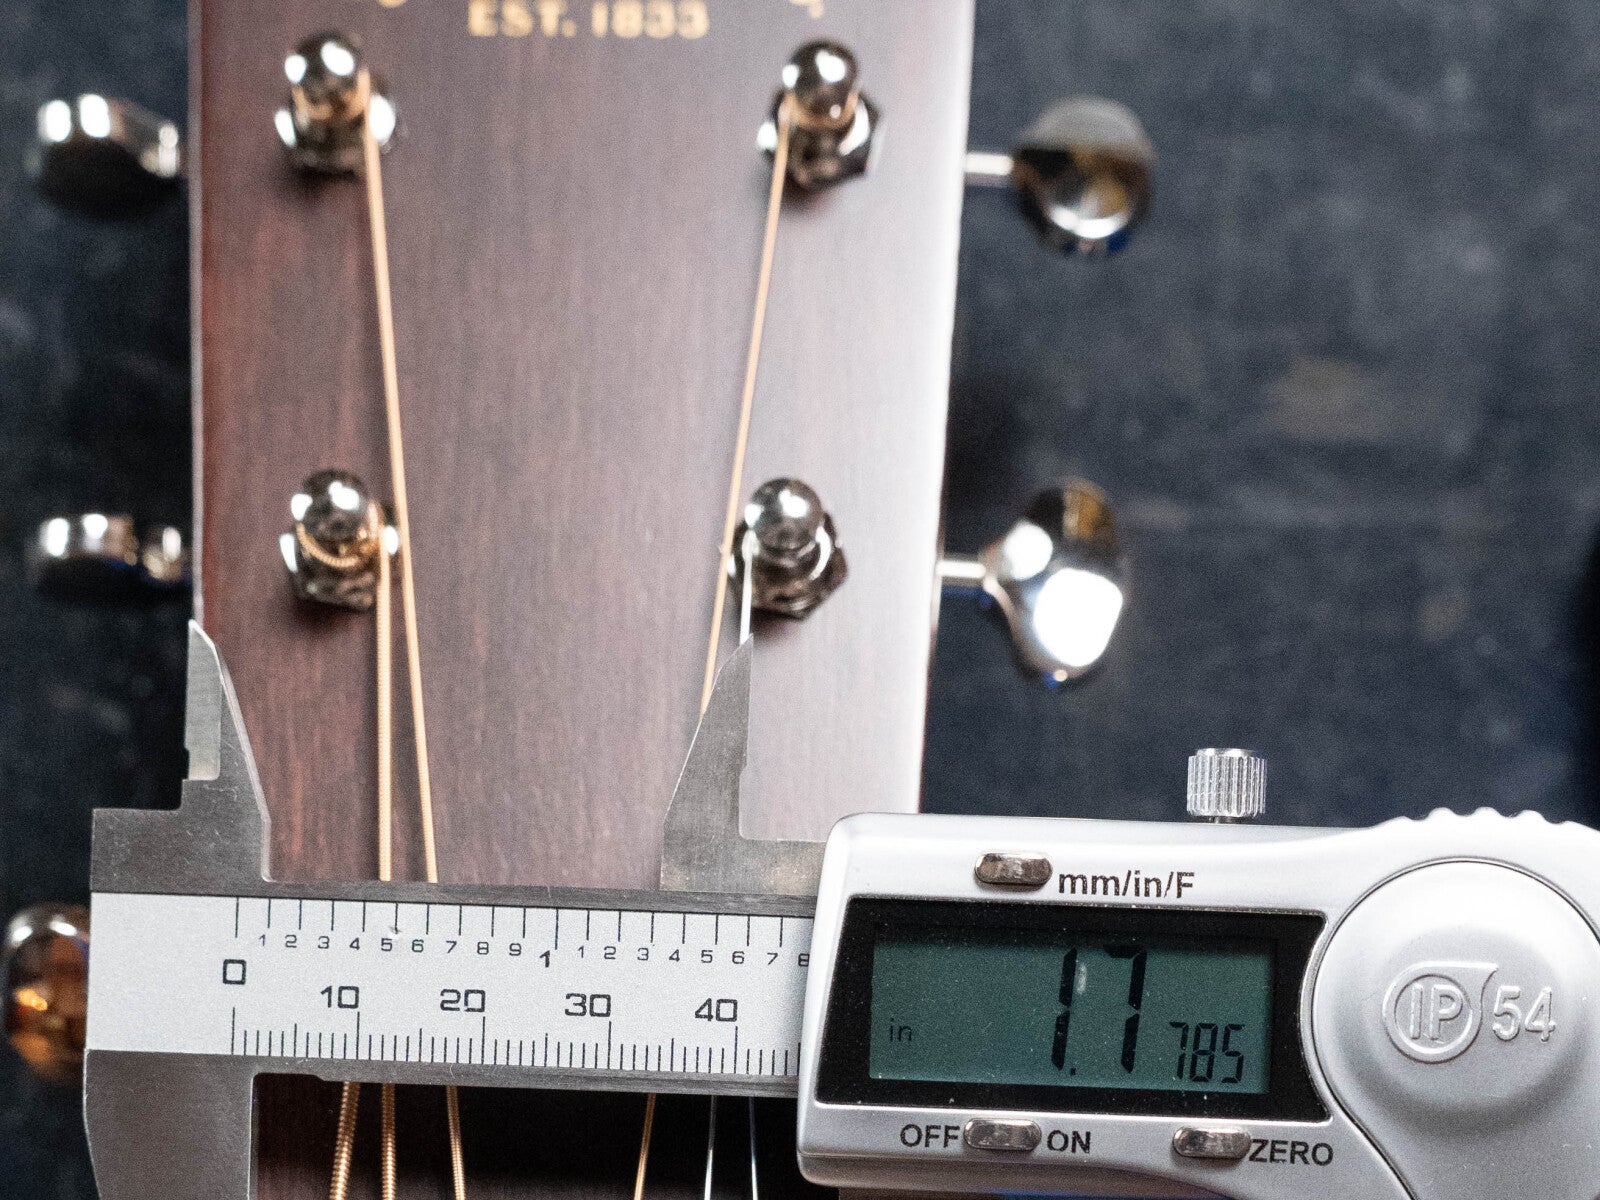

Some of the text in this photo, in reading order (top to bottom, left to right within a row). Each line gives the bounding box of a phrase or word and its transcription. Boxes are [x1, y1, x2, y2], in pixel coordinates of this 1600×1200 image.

[467, 0, 577, 37] EST.
[1059, 870, 1195, 898] mm/in/F
[259, 934, 266, 946] 1
[285, 934, 297, 948] 2
[318, 936, 330, 949] 3
[349, 938, 360, 950] 4
[381, 938, 393, 951] 5
[411, 939, 424, 953] 6
[445, 941, 457, 953] 7
[477, 941, 490, 955] 8
[509, 943, 522, 956] 9
[539, 950, 550, 968] 1
[578, 946, 584, 958] 1
[604, 946, 617, 960] 2
[637, 947, 650, 961] 3
[669, 949, 680, 962] 4
[700, 950, 713, 964] 5
[731, 951, 745, 964] 6
[767, 952, 778, 965] 7
[222, 959, 247, 985] 0
[320, 985, 738, 1022] 10 20 30 40
[1410, 983, 1556, 1042] IP 54
[889, 1017, 912, 1043] in
[900, 1124, 960, 1149] OFF
[1046, 1129, 1092, 1154] ON
[1248, 1138, 1334, 1167] ZERO
